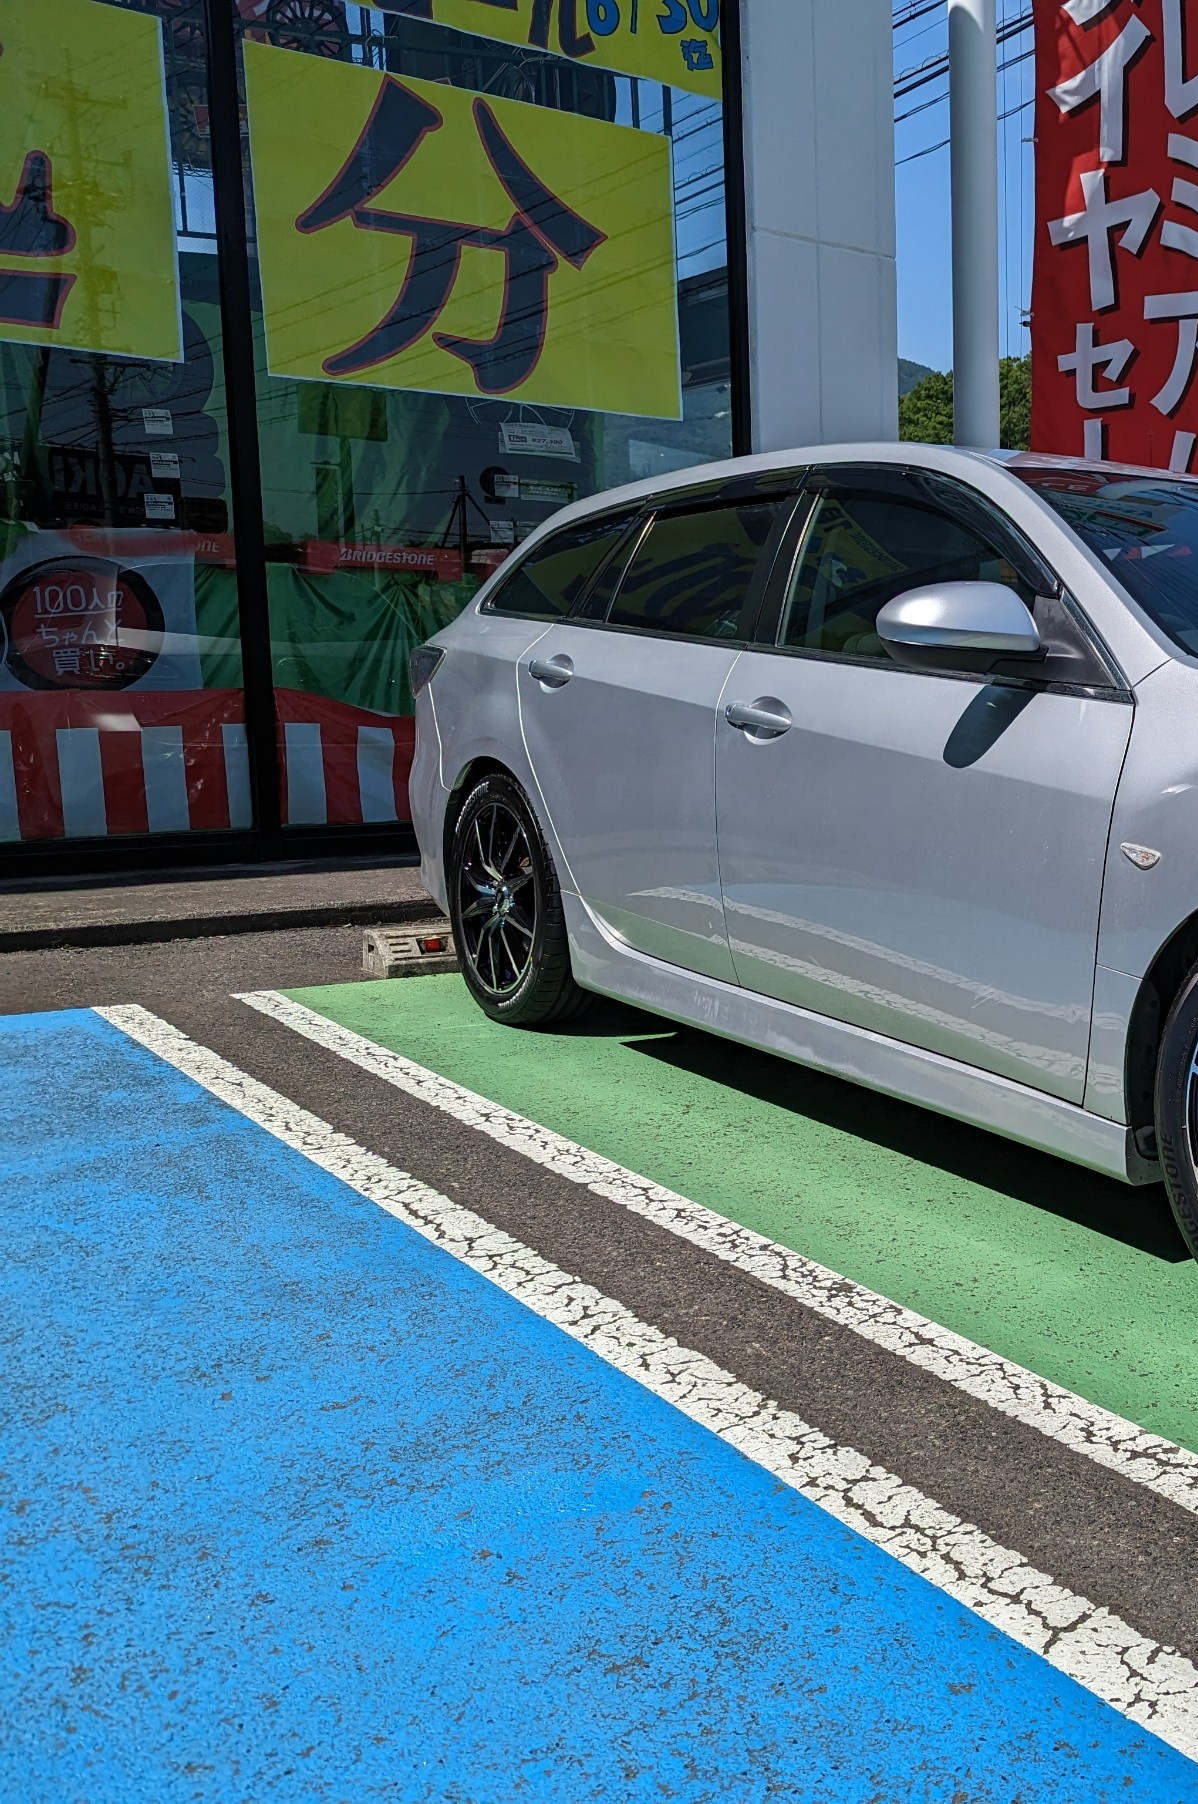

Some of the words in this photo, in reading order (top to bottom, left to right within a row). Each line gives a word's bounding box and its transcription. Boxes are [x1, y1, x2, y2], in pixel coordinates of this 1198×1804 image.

[340, 549, 434, 565] BRIDGESTONE
[32, 585, 124, 613] 100人の
[36, 618, 126, 648] ちゃんと
